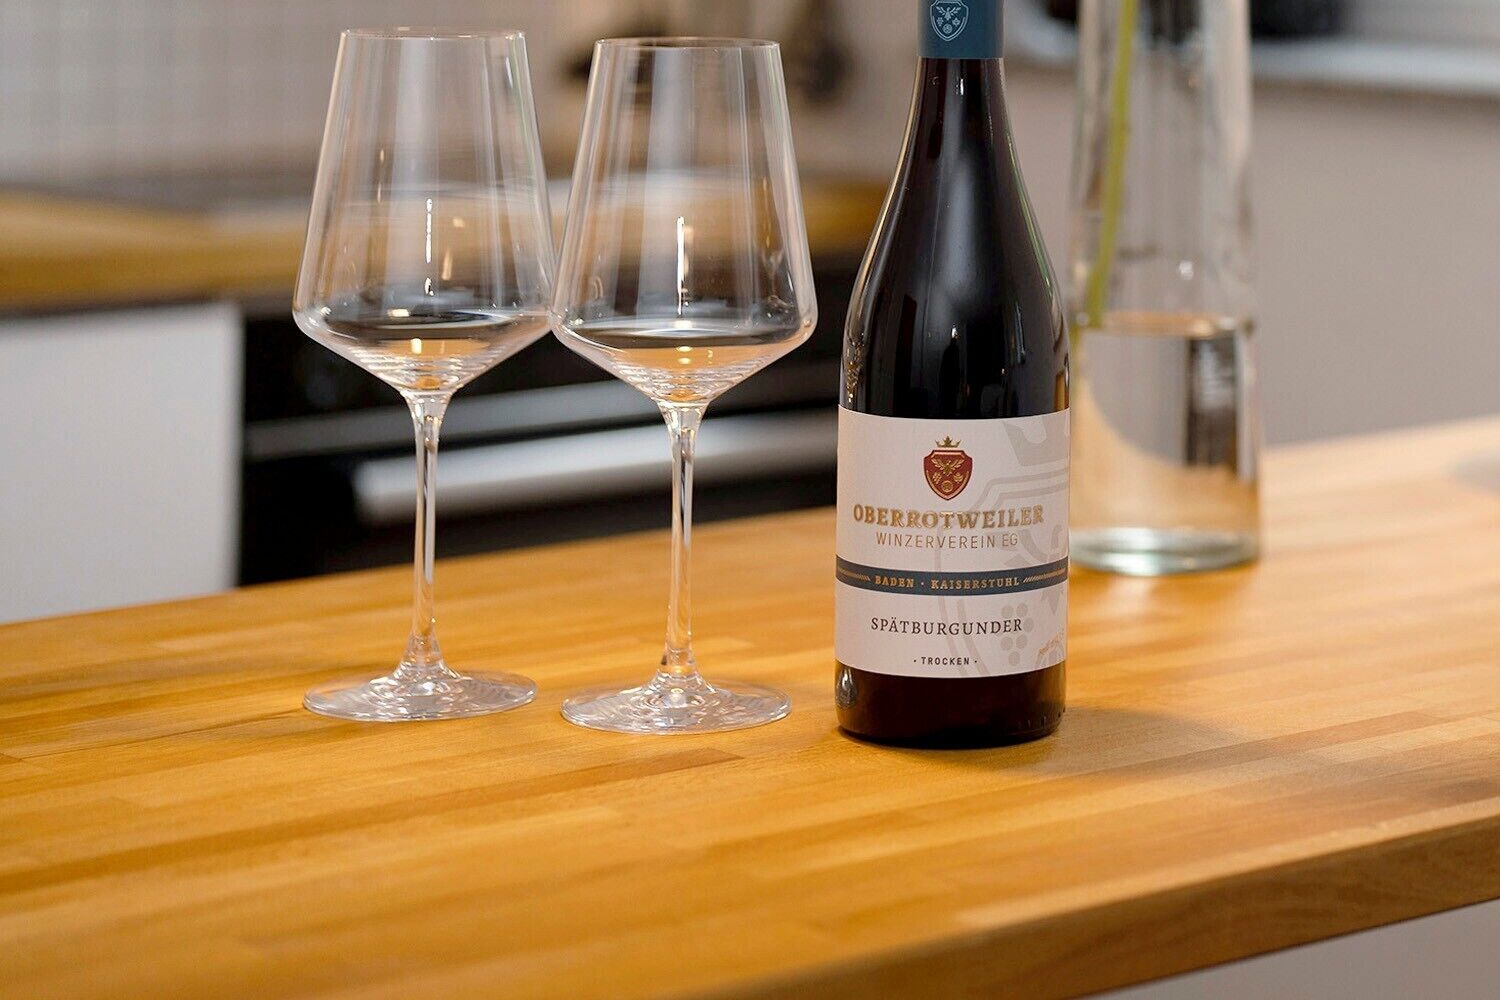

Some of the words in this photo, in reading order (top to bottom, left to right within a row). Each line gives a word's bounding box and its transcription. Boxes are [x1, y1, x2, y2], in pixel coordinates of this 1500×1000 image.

[853, 503, 1045, 529] OBERROTWEILER
[876, 531, 995, 549] WINZERVEREIN
[874, 575, 914, 588] BADEN
[931, 576, 1020, 590] KAISERSTUHL
[870, 616, 1023, 635] SPÄTBURGUNDER
[921, 656, 970, 665] TROCKEN
